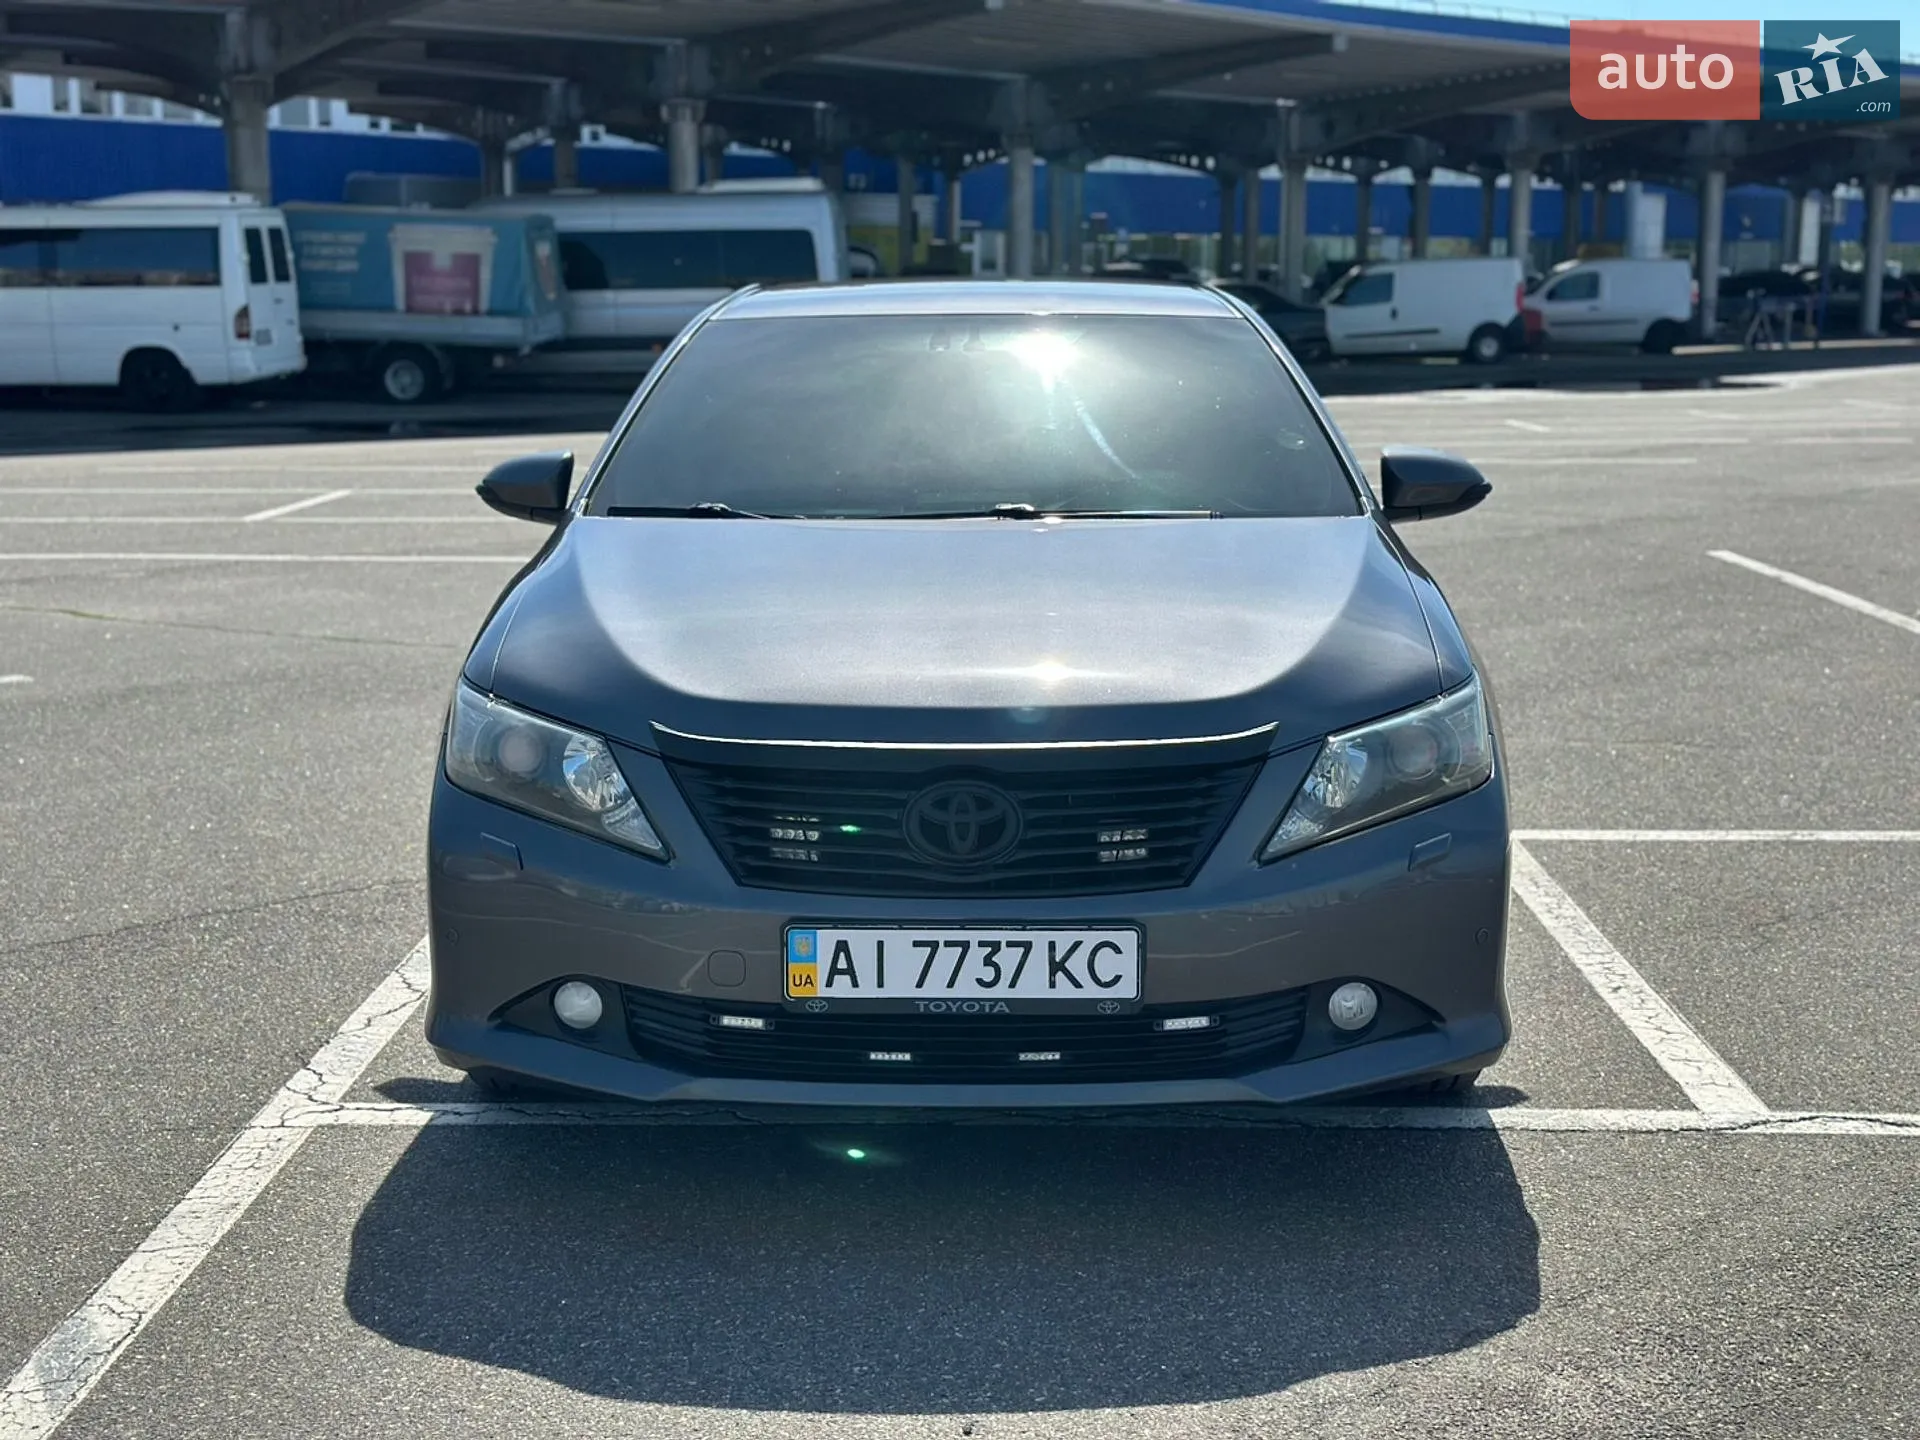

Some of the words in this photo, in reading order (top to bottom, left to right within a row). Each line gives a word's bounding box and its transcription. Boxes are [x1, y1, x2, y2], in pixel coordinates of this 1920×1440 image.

[825, 940, 885, 988] AI
[912, 940, 1033, 988] 7737
[1047, 940, 1123, 989] KC
[793, 974, 814, 988] UA
[915, 1001, 1010, 1013] TOYOTA
